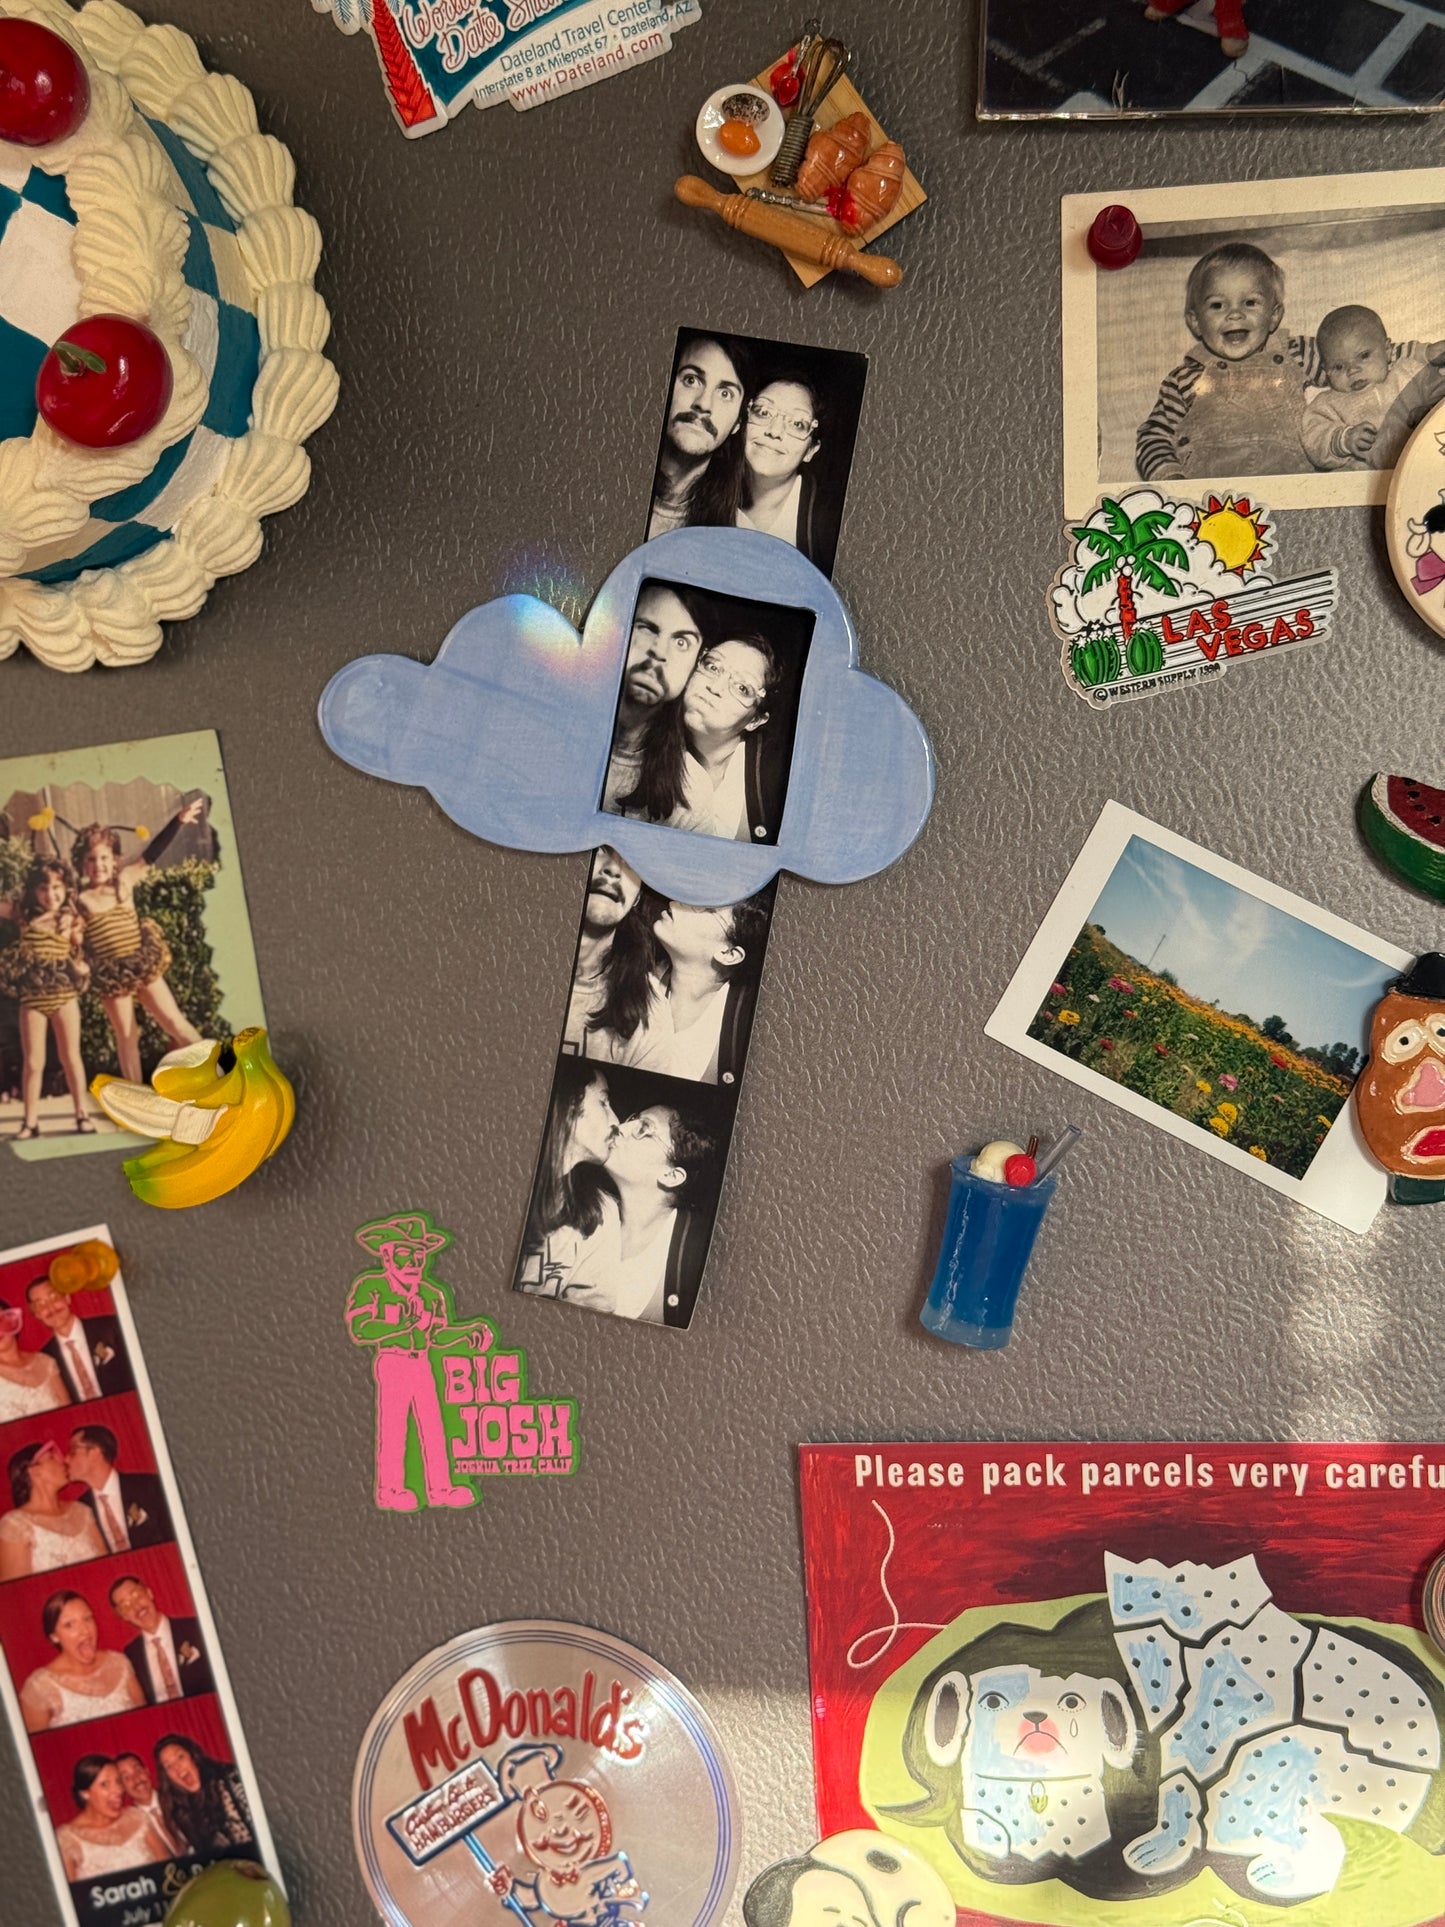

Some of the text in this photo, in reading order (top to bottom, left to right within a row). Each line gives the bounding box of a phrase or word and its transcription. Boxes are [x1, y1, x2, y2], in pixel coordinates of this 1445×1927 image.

[440, 9, 501, 70] Date
[475, 0, 693, 99] Interstate 8 at Milepost 67 Dateland, AZ
[500, 0, 652, 72] Dateland Travel Center
[512, 33, 664, 101] www.Dateland.com
[1161, 600, 1232, 644] LAS
[1196, 608, 1315, 662] VEGAS
[1109, 678, 1157, 697] WESTERN
[1158, 668, 1197, 685] SUPPLY
[442, 1354, 521, 1404] BIG
[452, 1404, 573, 1458] JOSH
[454, 1459, 501, 1473] JOSHUA
[854, 1454, 965, 1488] Please
[982, 1453, 1068, 1495] pack
[1081, 1453, 1214, 1495] parcels
[1228, 1462, 1310, 1497] very
[402, 1667, 648, 1791] McDonald's
[412, 1788, 496, 1851] HAMBURGERS
[90, 1875, 157, 1908] Sarah
[121, 1905, 152, 1926] July
